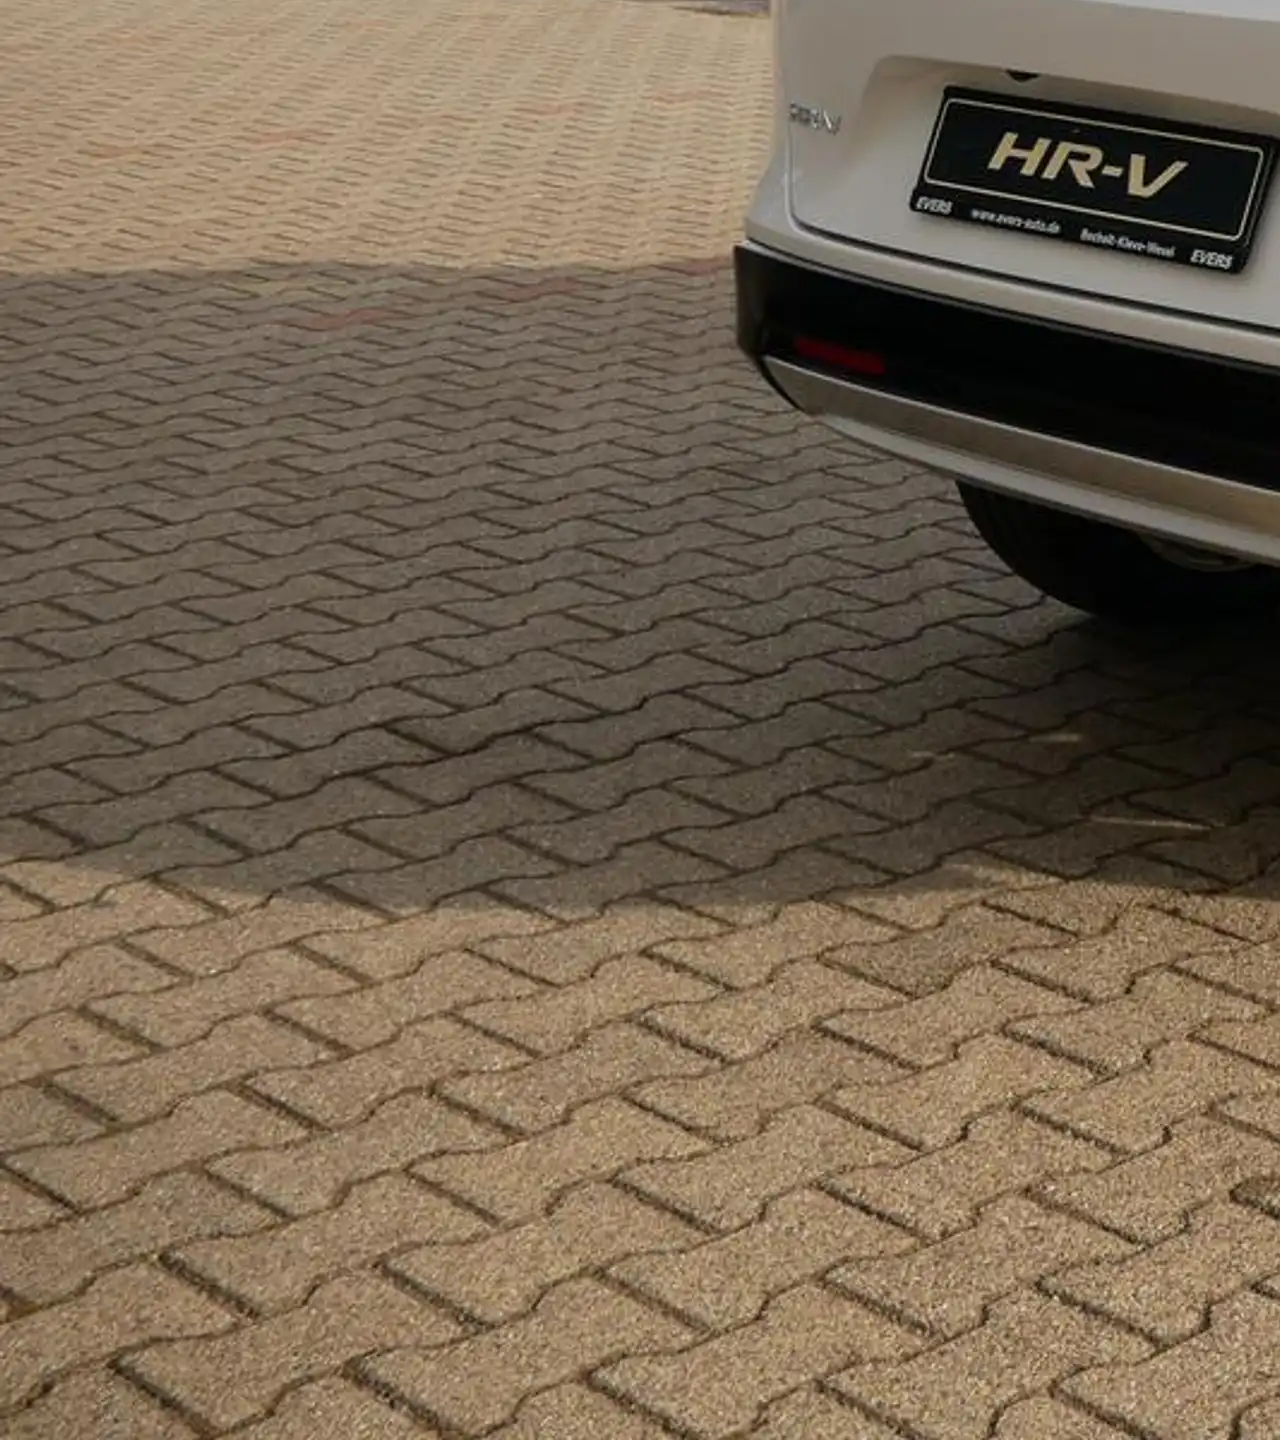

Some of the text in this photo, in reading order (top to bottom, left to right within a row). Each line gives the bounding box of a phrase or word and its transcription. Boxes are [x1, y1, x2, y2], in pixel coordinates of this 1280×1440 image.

[987, 131, 1188, 199] HR-V
[916, 196, 953, 215] EVERS
[1190, 248, 1233, 270] EVERS
